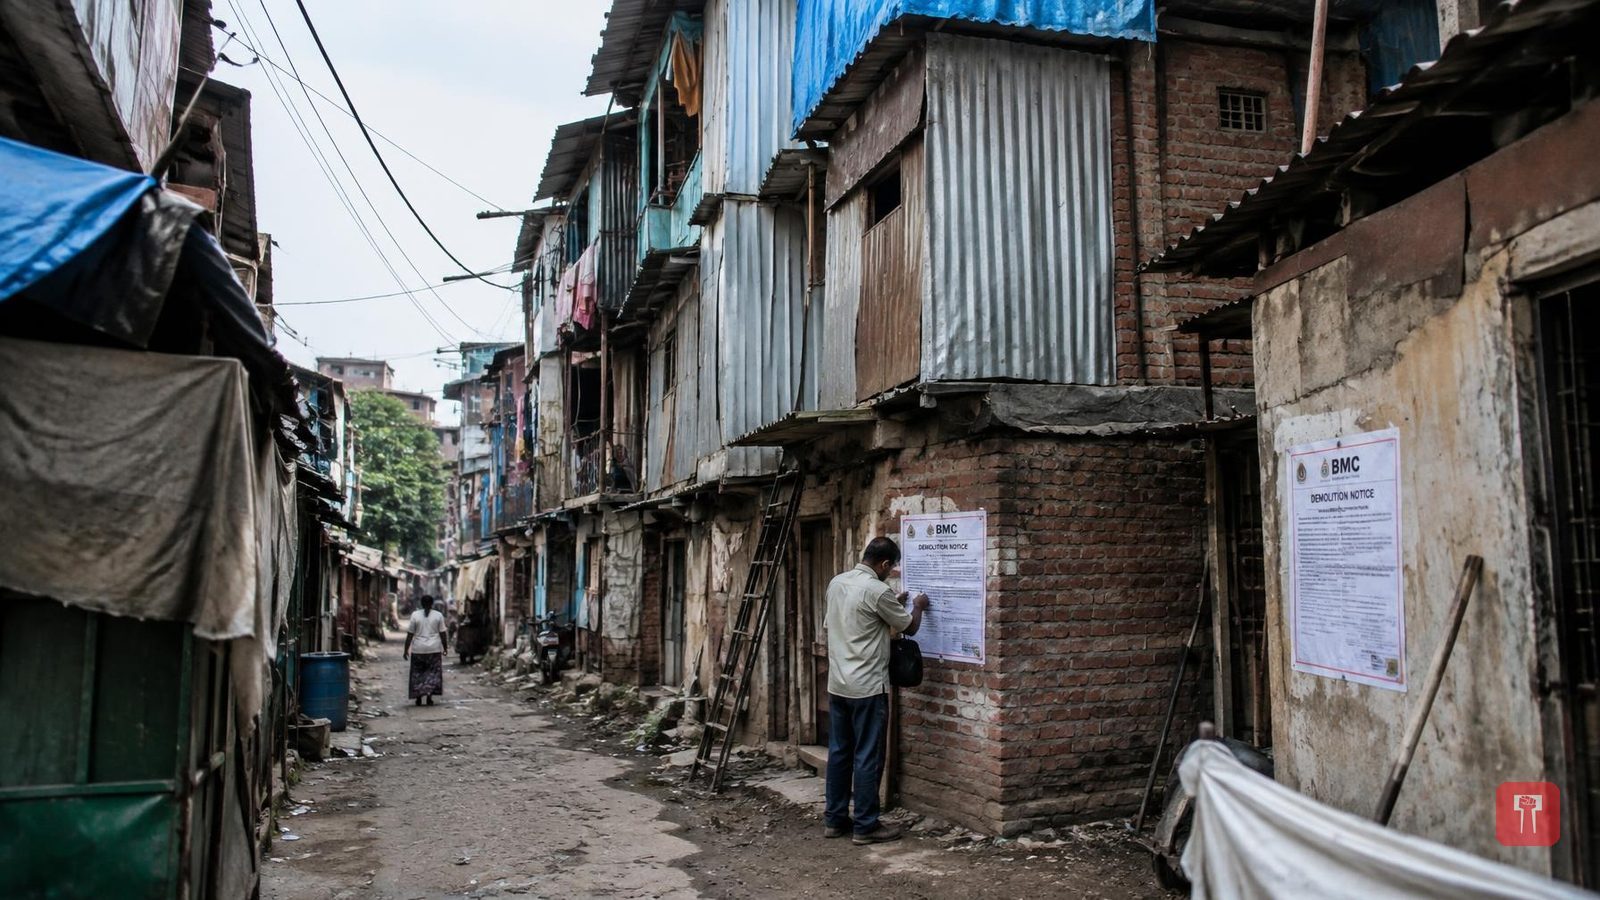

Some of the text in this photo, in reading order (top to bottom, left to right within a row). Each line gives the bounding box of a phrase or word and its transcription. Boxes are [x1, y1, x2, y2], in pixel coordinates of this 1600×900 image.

[1331, 456, 1360, 475] BMC
[1310, 489, 1375, 503] DEMOLITION NOTICE
[936, 523, 958, 534] BMC
[918, 543, 948, 551] DEMOLITION
